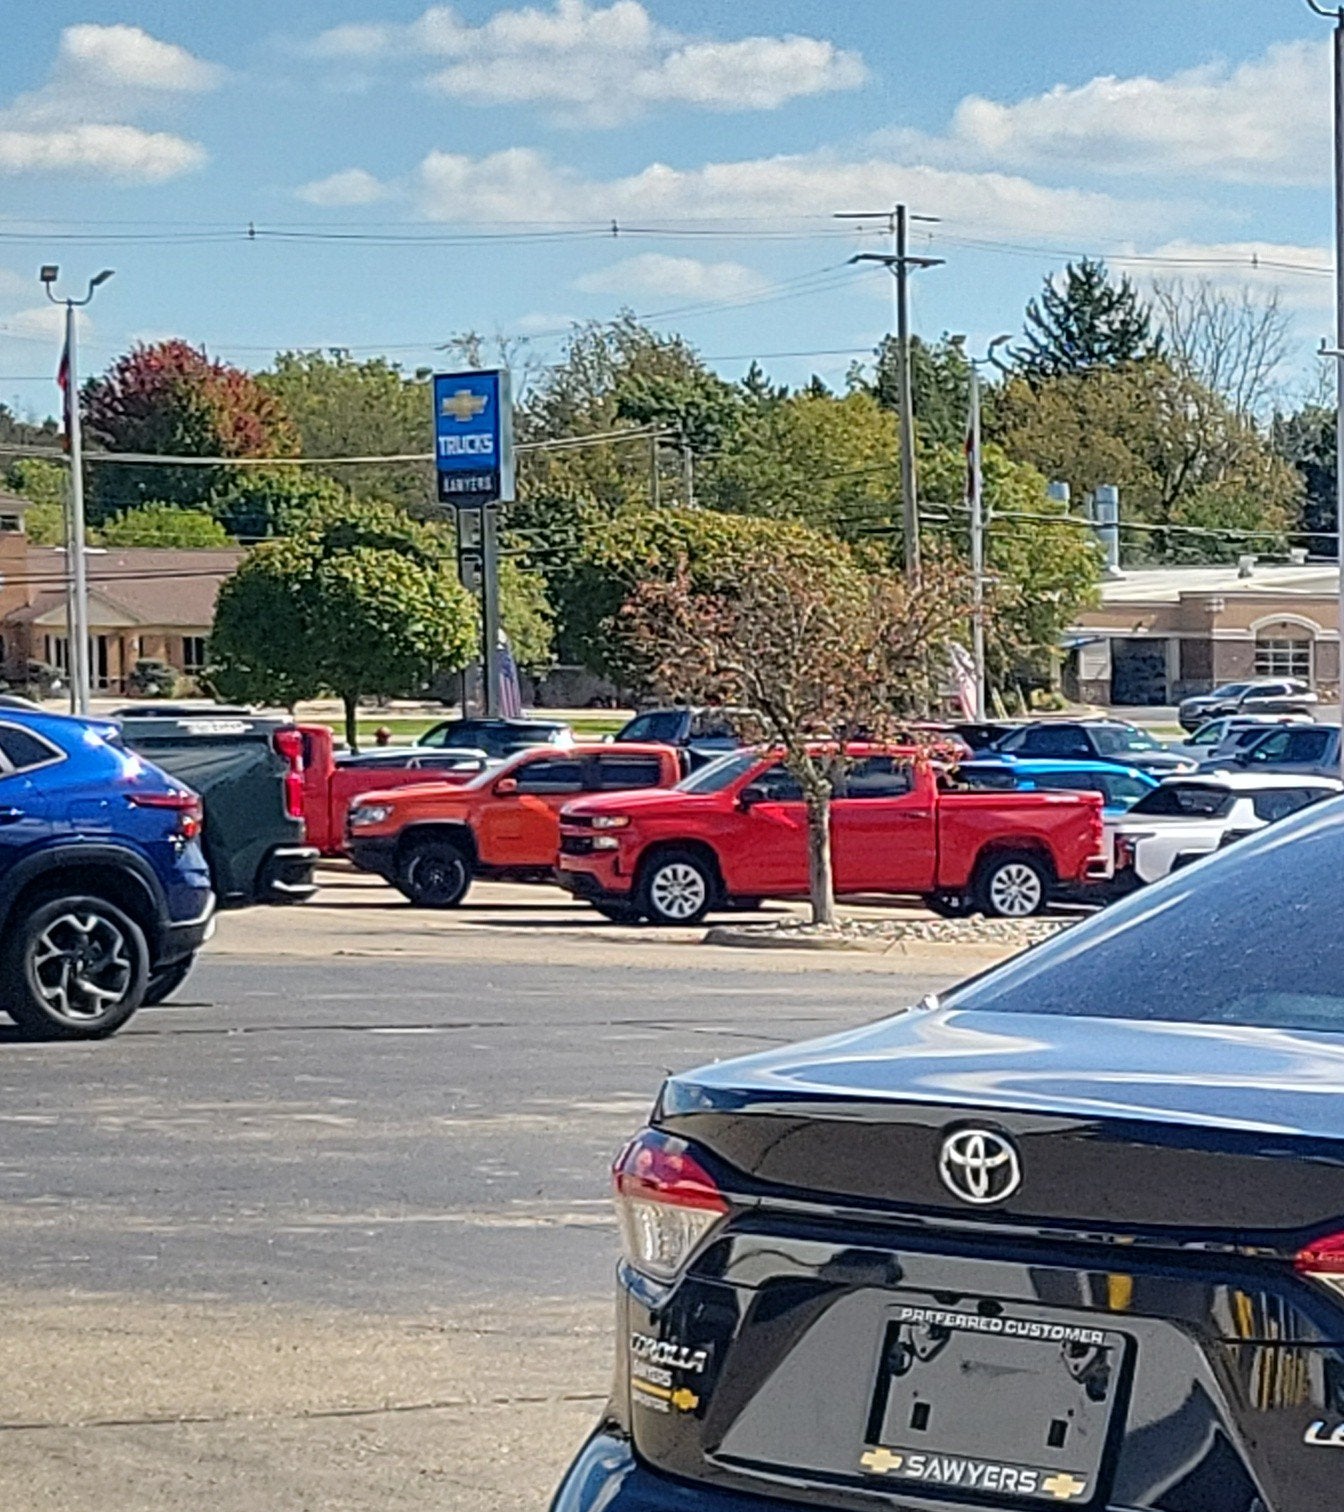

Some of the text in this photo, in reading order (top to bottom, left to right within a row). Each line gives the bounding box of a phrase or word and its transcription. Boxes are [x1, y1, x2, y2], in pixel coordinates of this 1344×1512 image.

[438, 433, 494, 456] TRUCKS
[900, 1307, 1104, 1344] PREFERRED CUSTOMER
[906, 1455, 1038, 1492] SAWYERS
